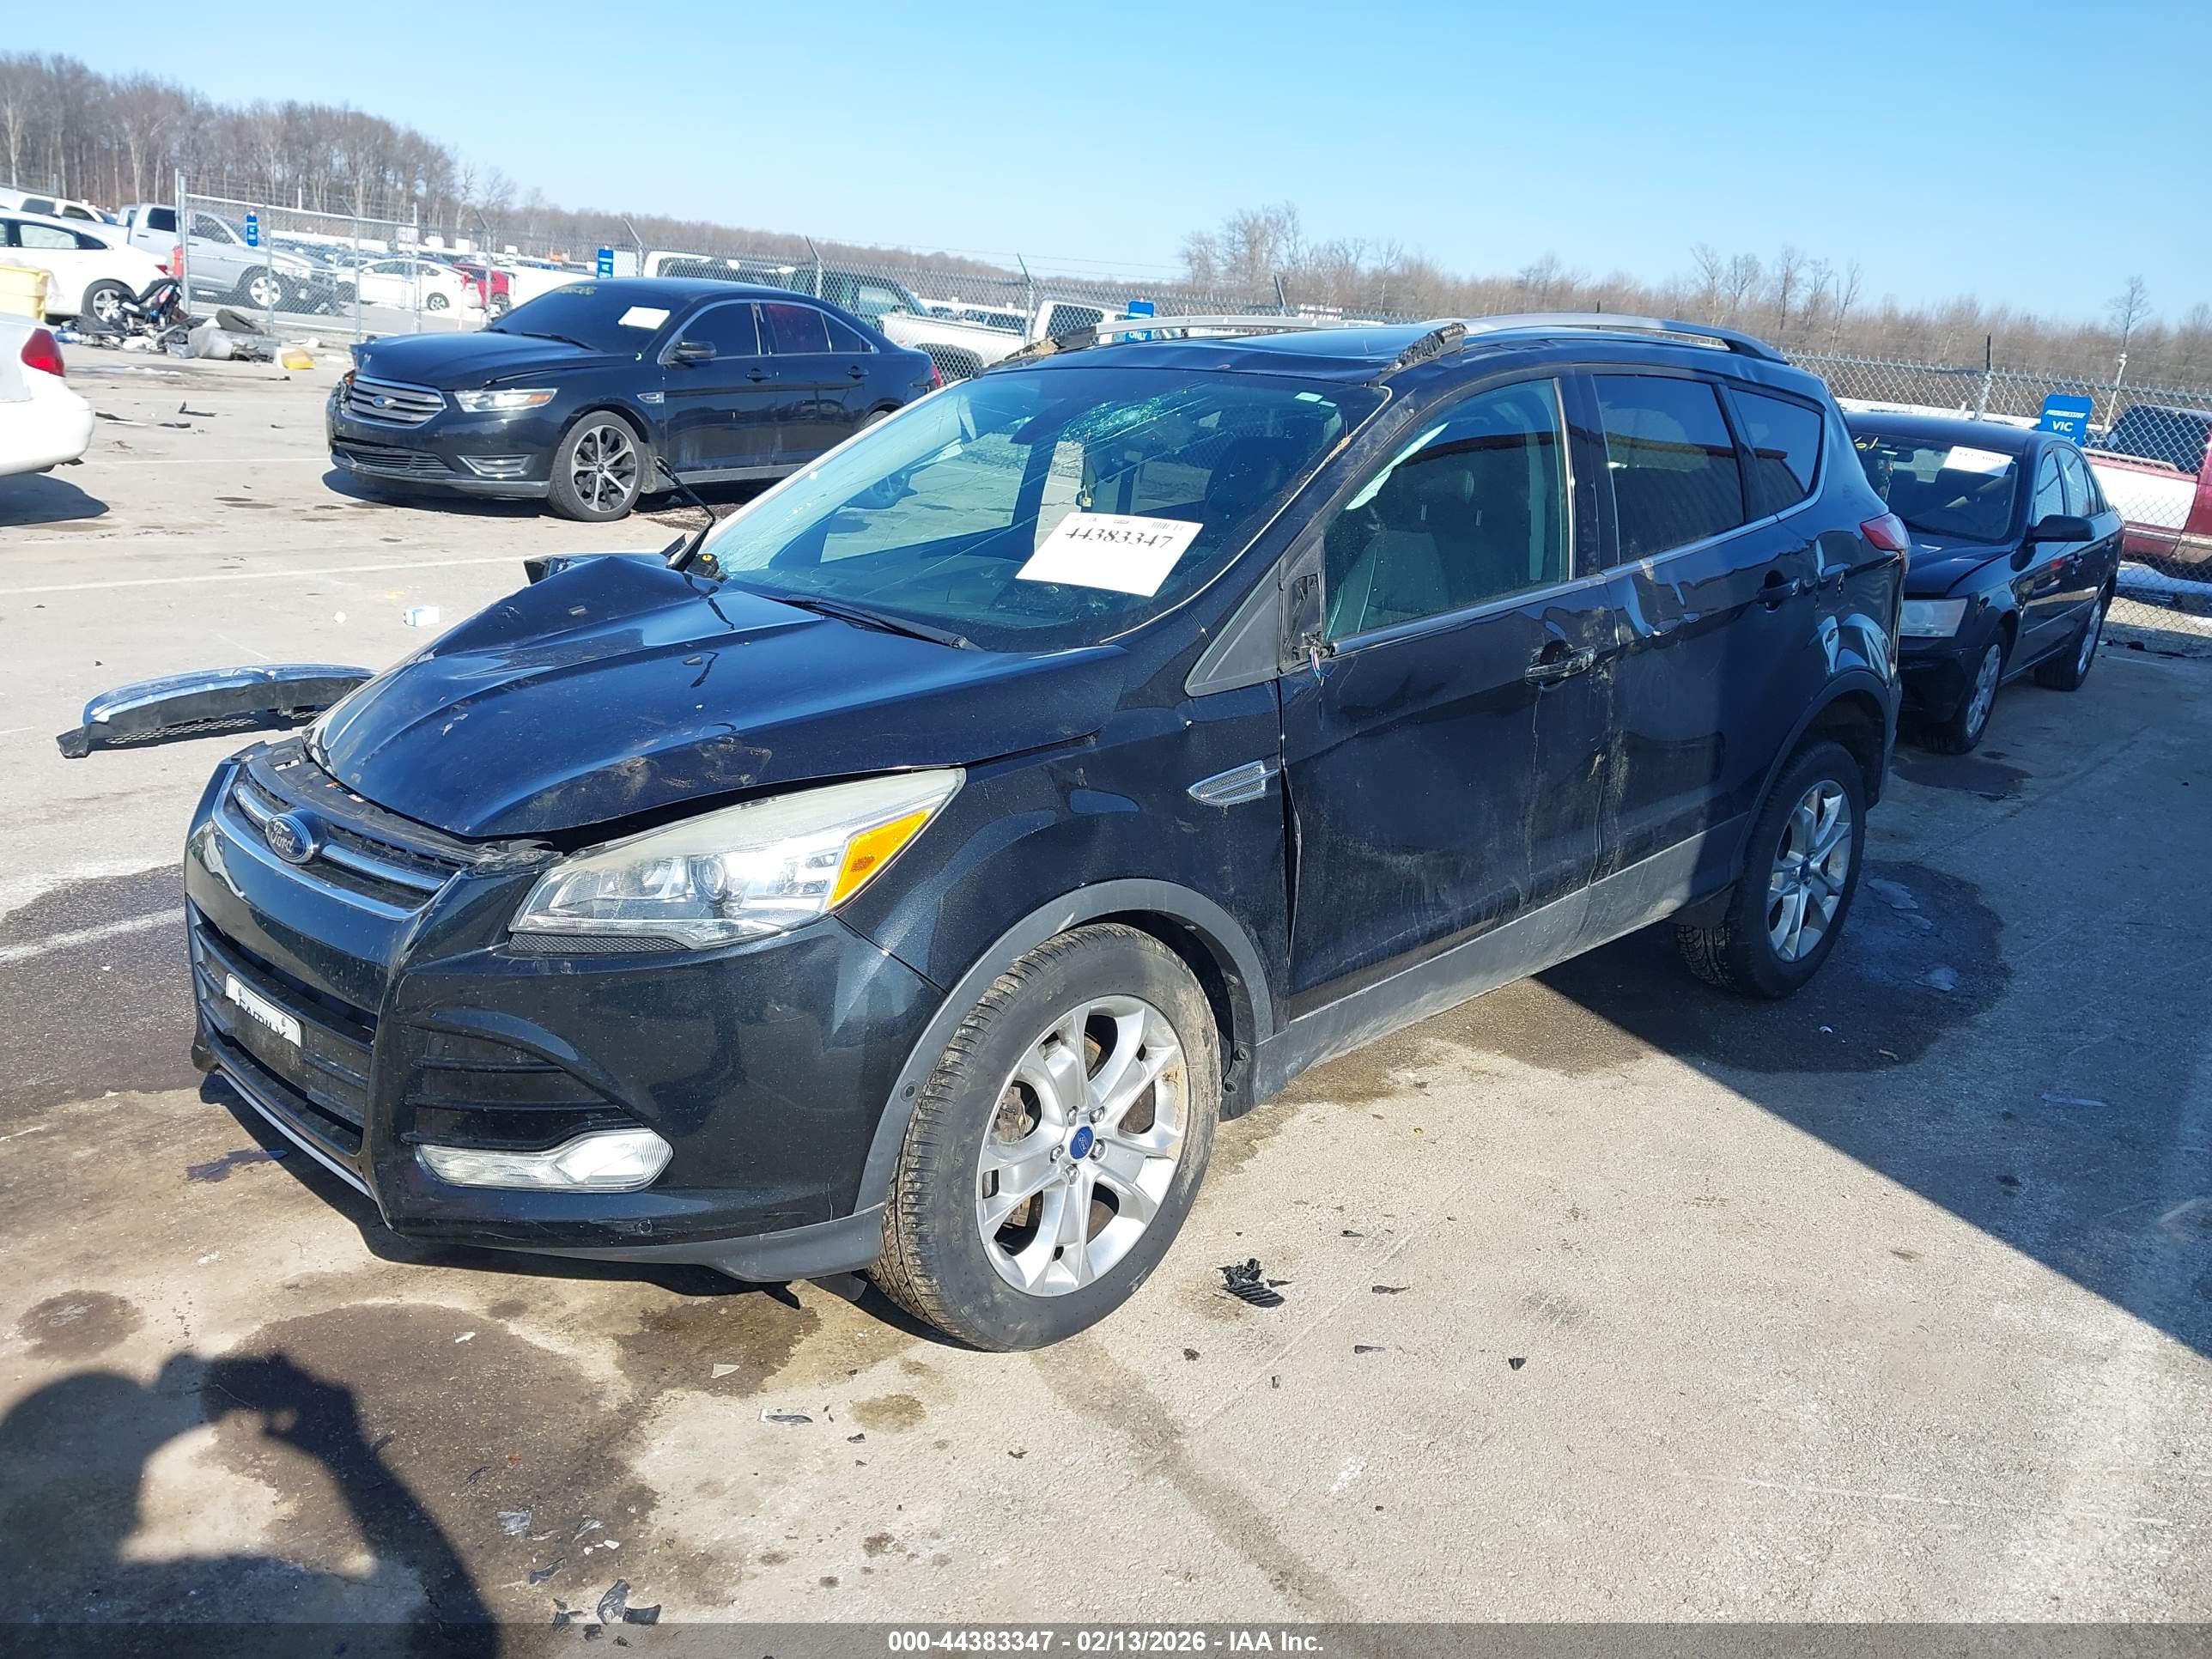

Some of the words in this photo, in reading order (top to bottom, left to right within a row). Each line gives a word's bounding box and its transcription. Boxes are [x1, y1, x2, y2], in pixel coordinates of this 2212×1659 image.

[2052, 420, 2074, 432] VIC
[1065, 526, 1174, 549] 44383347
[270, 820, 296, 854] Ford
